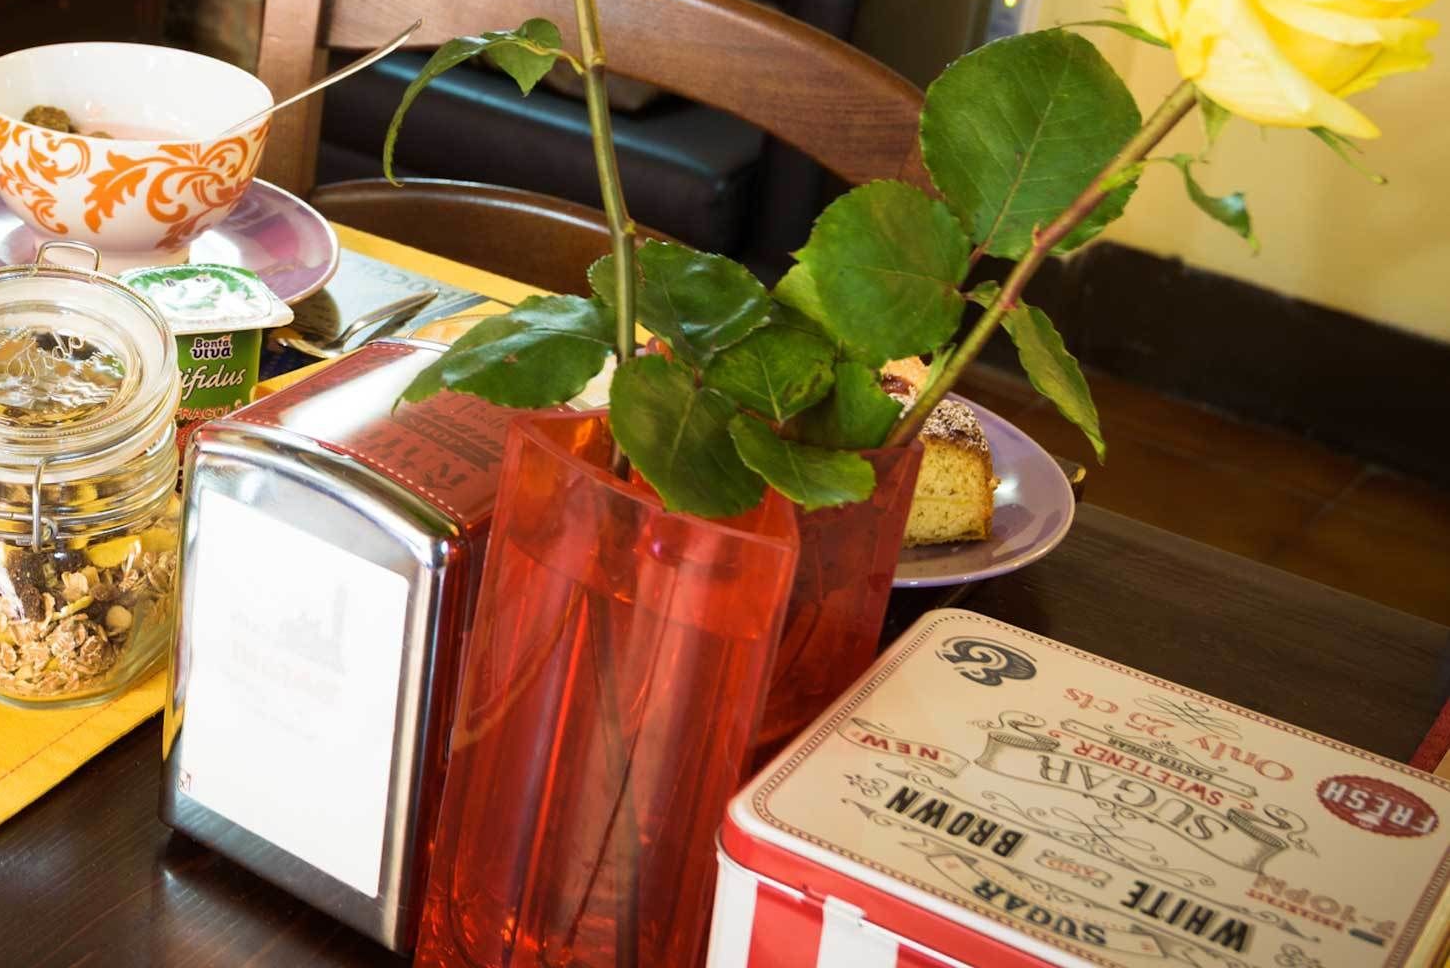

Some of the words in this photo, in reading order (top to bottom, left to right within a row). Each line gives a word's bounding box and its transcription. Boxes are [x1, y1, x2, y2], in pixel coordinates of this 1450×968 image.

[192, 347, 232, 359] viva
[180, 364, 247, 401] ifidus
[178, 407, 231, 420] FRAGOL
[860, 734, 940, 761] NEW
[1072, 739, 1225, 806] SWEETENER
[1186, 733, 1295, 781] Only
[885, 785, 1024, 858] BROWN
[1037, 754, 1230, 841] SUGAR
[1322, 781, 1437, 835] FRESH
[971, 879, 1108, 947] SUGAR
[1119, 880, 1250, 953] WHITE
